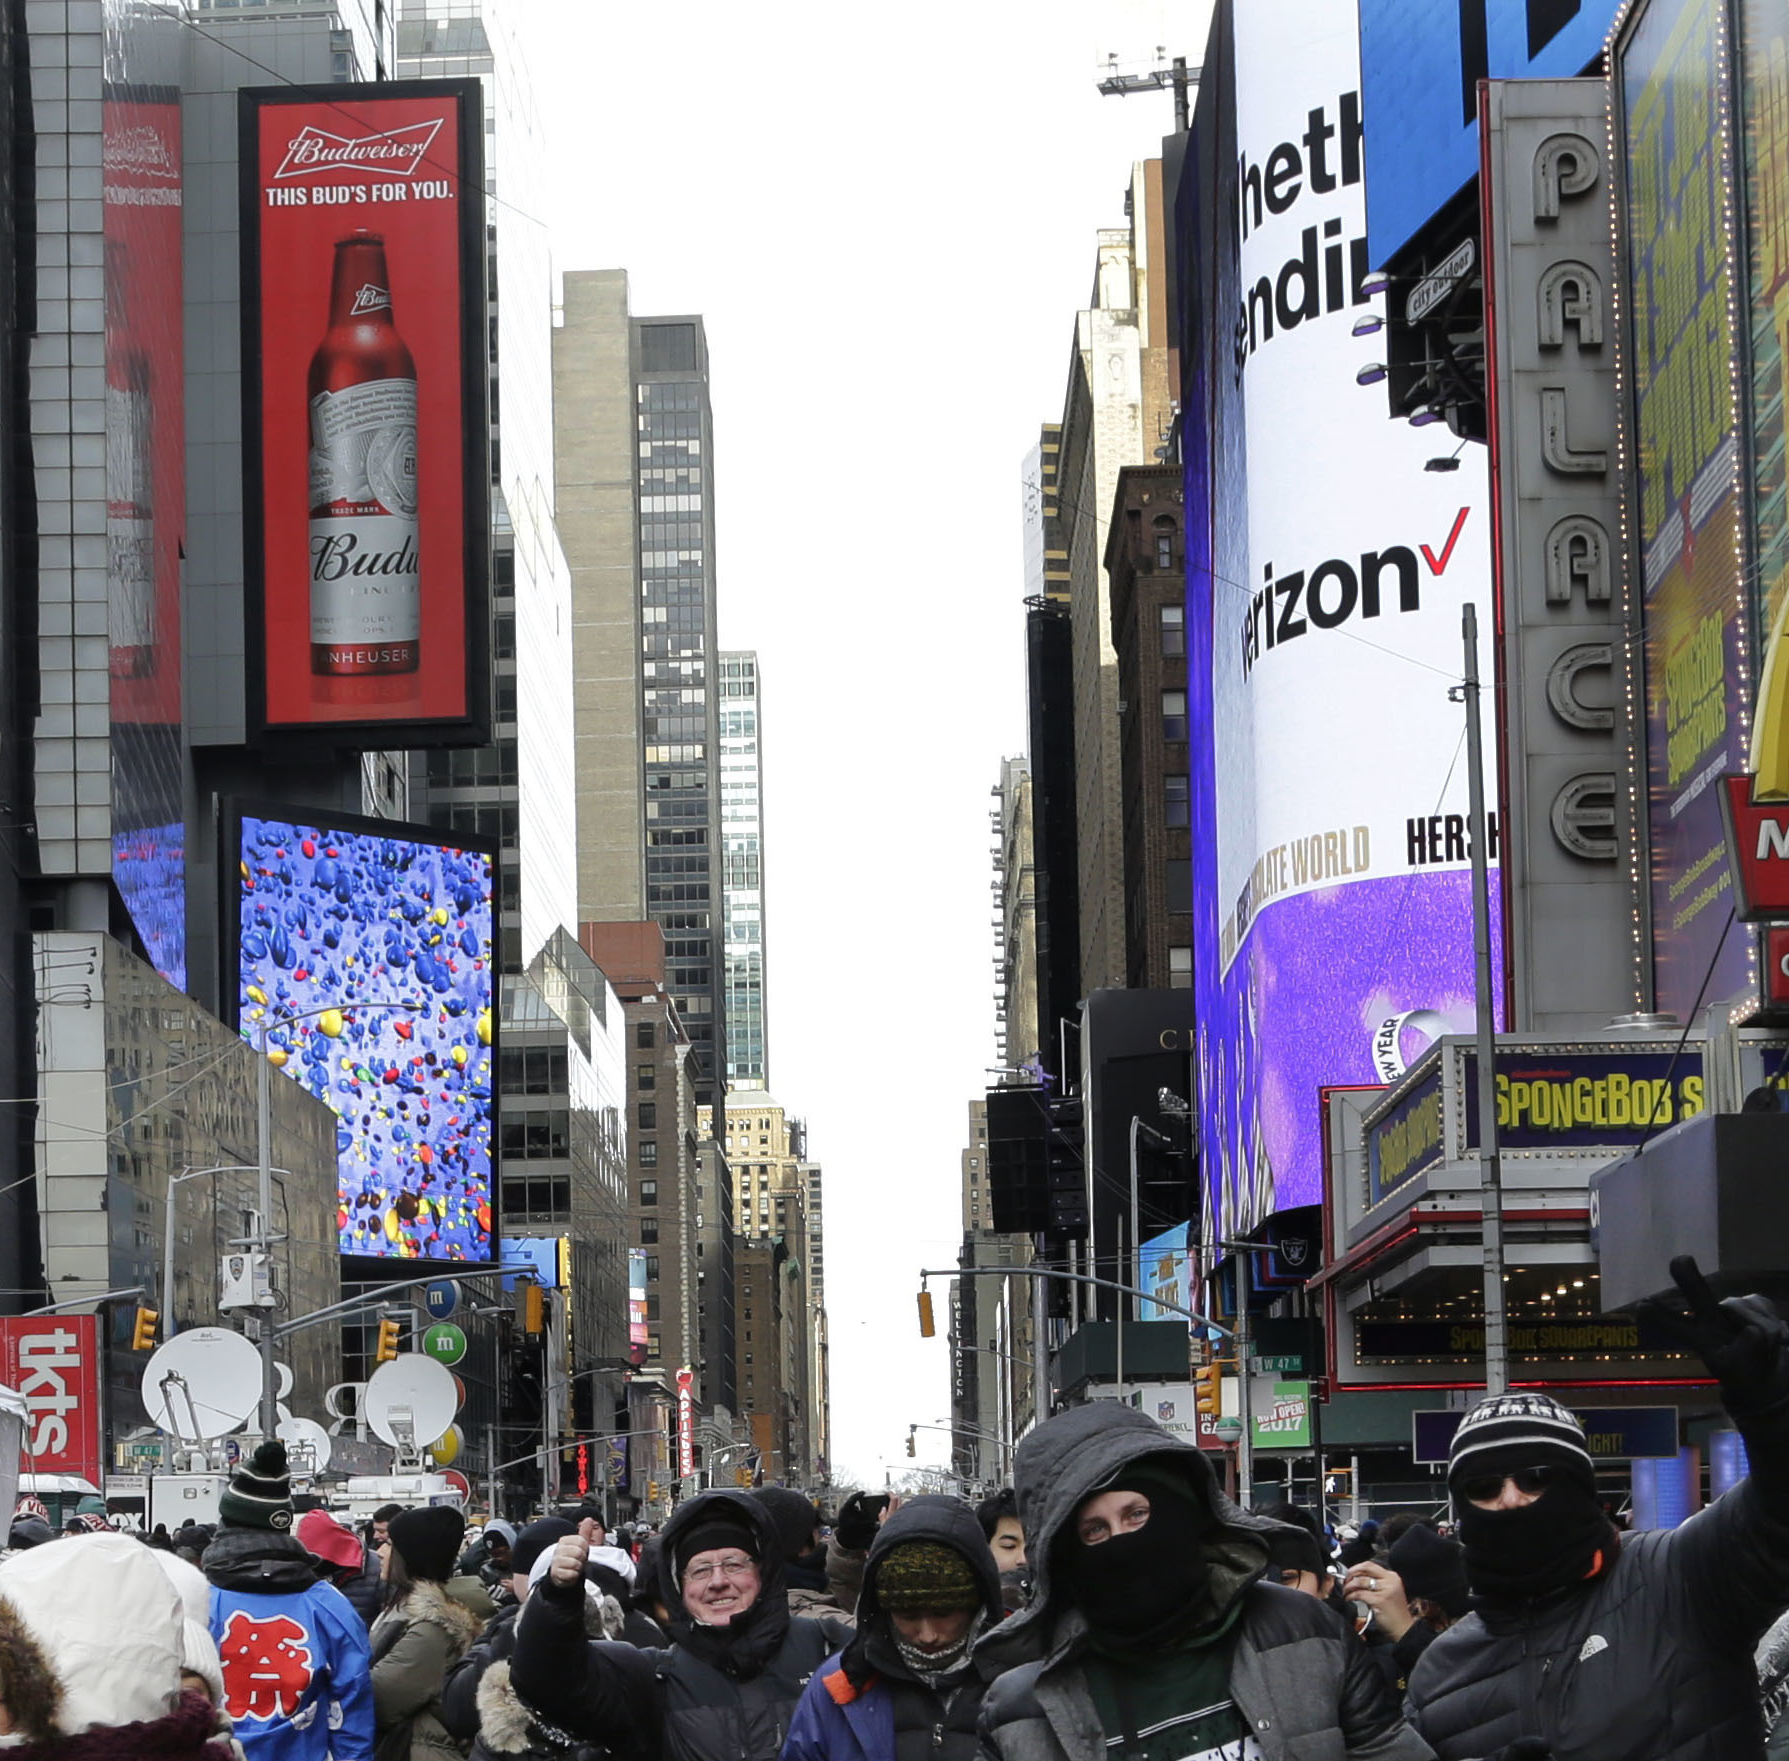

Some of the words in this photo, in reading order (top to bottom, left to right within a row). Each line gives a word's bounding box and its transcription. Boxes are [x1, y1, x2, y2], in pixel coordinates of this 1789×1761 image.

[288, 138, 424, 164] Budweiser
[266, 187, 307, 206] THIS
[312, 185, 366, 205] BUD'S
[372, 183, 406, 202] FOR
[411, 180, 454, 200] YOU.
[1532, 131, 1616, 860] PALACE
[1290, 825, 1371, 887] WORLD
[1376, 1018, 1400, 1055] YEAR
[1495, 1072, 1673, 1130] SPONGEBOB
[1264, 1356, 1274, 1369] W
[1277, 1356, 1289, 1369] 47
[18, 1327, 81, 1458] tkts
[1278, 1401, 1306, 1419] OPEN!
[1258, 1416, 1303, 1433] 2017
[219, 1609, 313, 1721] 祭
